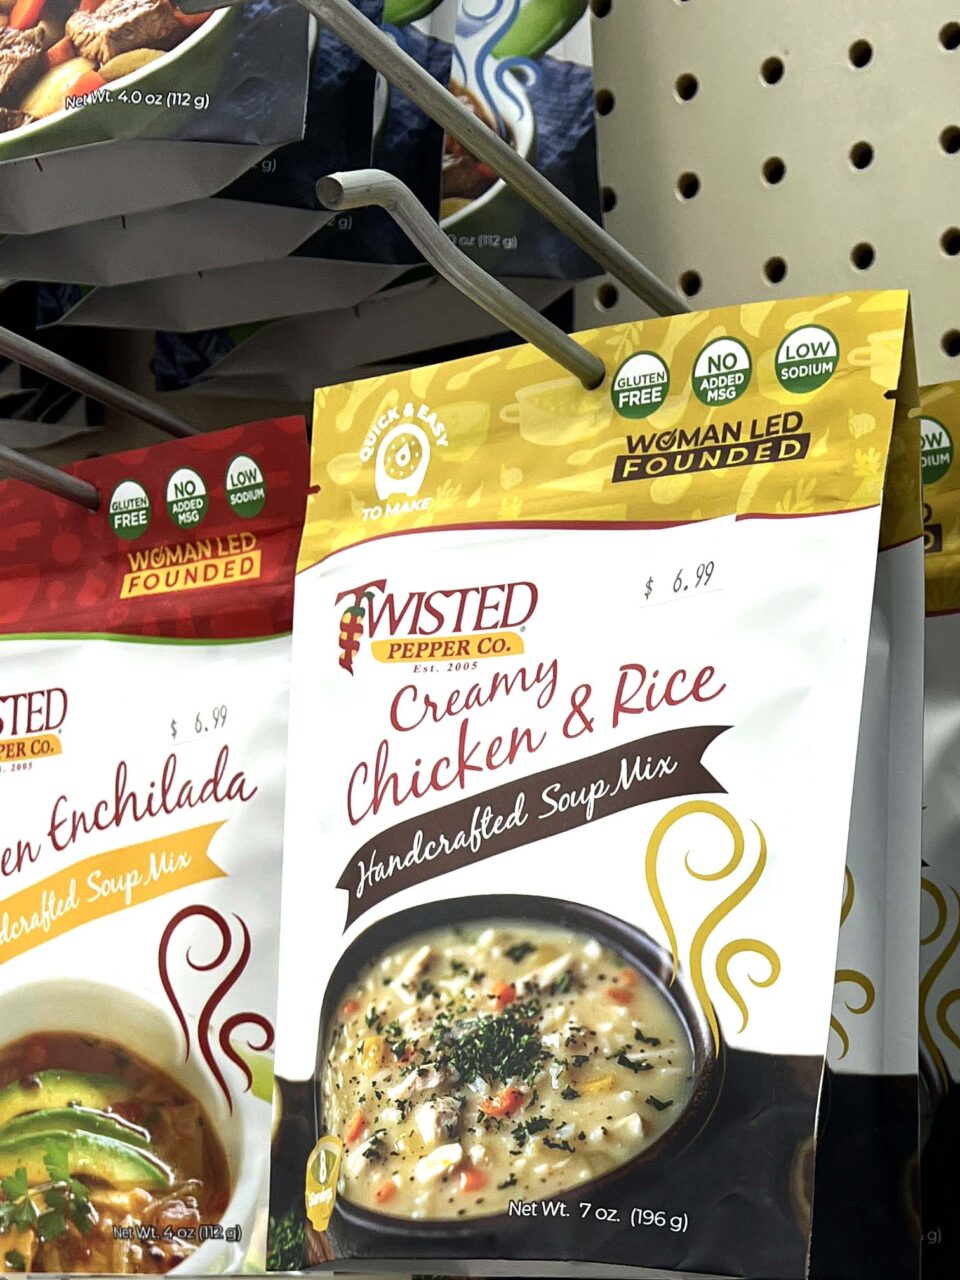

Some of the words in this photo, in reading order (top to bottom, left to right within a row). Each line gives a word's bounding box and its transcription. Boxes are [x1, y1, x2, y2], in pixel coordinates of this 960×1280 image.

[87, 89, 113, 104] Wt.
[118, 90, 142, 104] 4.0
[145, 94, 163, 105] oz
[166, 93, 190, 108] (112
[194, 93, 210, 109] g)
[785, 341, 831, 361] LOW
[708, 352, 738, 372] NO
[781, 362, 833, 381] SODIUM
[617, 371, 665, 390] GLUTEN
[700, 373, 744, 391] ADDED
[618, 388, 662, 408] FREE
[707, 386, 736, 402] MSG
[626, 422, 742, 454] WOMAN
[750, 411, 803, 440] LED
[621, 439, 802, 478] FOUNDED
[230, 468, 257, 487] LOW
[174, 480, 196, 498] NO
[230, 488, 264, 505] SODIUM
[112, 498, 147, 511] GLUTEN
[172, 499, 203, 514] ADDED
[114, 510, 147, 529] FREE
[178, 510, 199, 524] MSG
[128, 539, 212, 571] WOMAN
[216, 532, 256, 556] LED
[128, 557, 254, 593] FOUNDED
[644, 576, 654, 600] $
[672, 561, 715, 593] 6.99
[335, 579, 538, 677] TWISTED
[387, 638, 470, 660] PEPPER
[390, 658, 558, 732] Creamy
[170, 719, 177, 740] $
[195, 704, 228, 733] 6.99
[346, 719, 547, 825] Chicken
[562, 683, 594, 738] &
[612, 663, 727, 729] Rice
[48, 744, 258, 851] Enchilada
[356, 792, 528, 899] Handcrafted
[538, 778, 610, 820] Soup
[610, 754, 678, 797] Mix
[86, 869, 144, 905] Soup
[143, 850, 192, 885] Mix
[508, 1201, 537, 1217] Net
[542, 1201, 570, 1217] Wt.
[579, 1202, 592, 1218] 7
[595, 1207, 620, 1222] oz.
[631, 1208, 666, 1227] (196
[670, 1213, 689, 1233] g)
